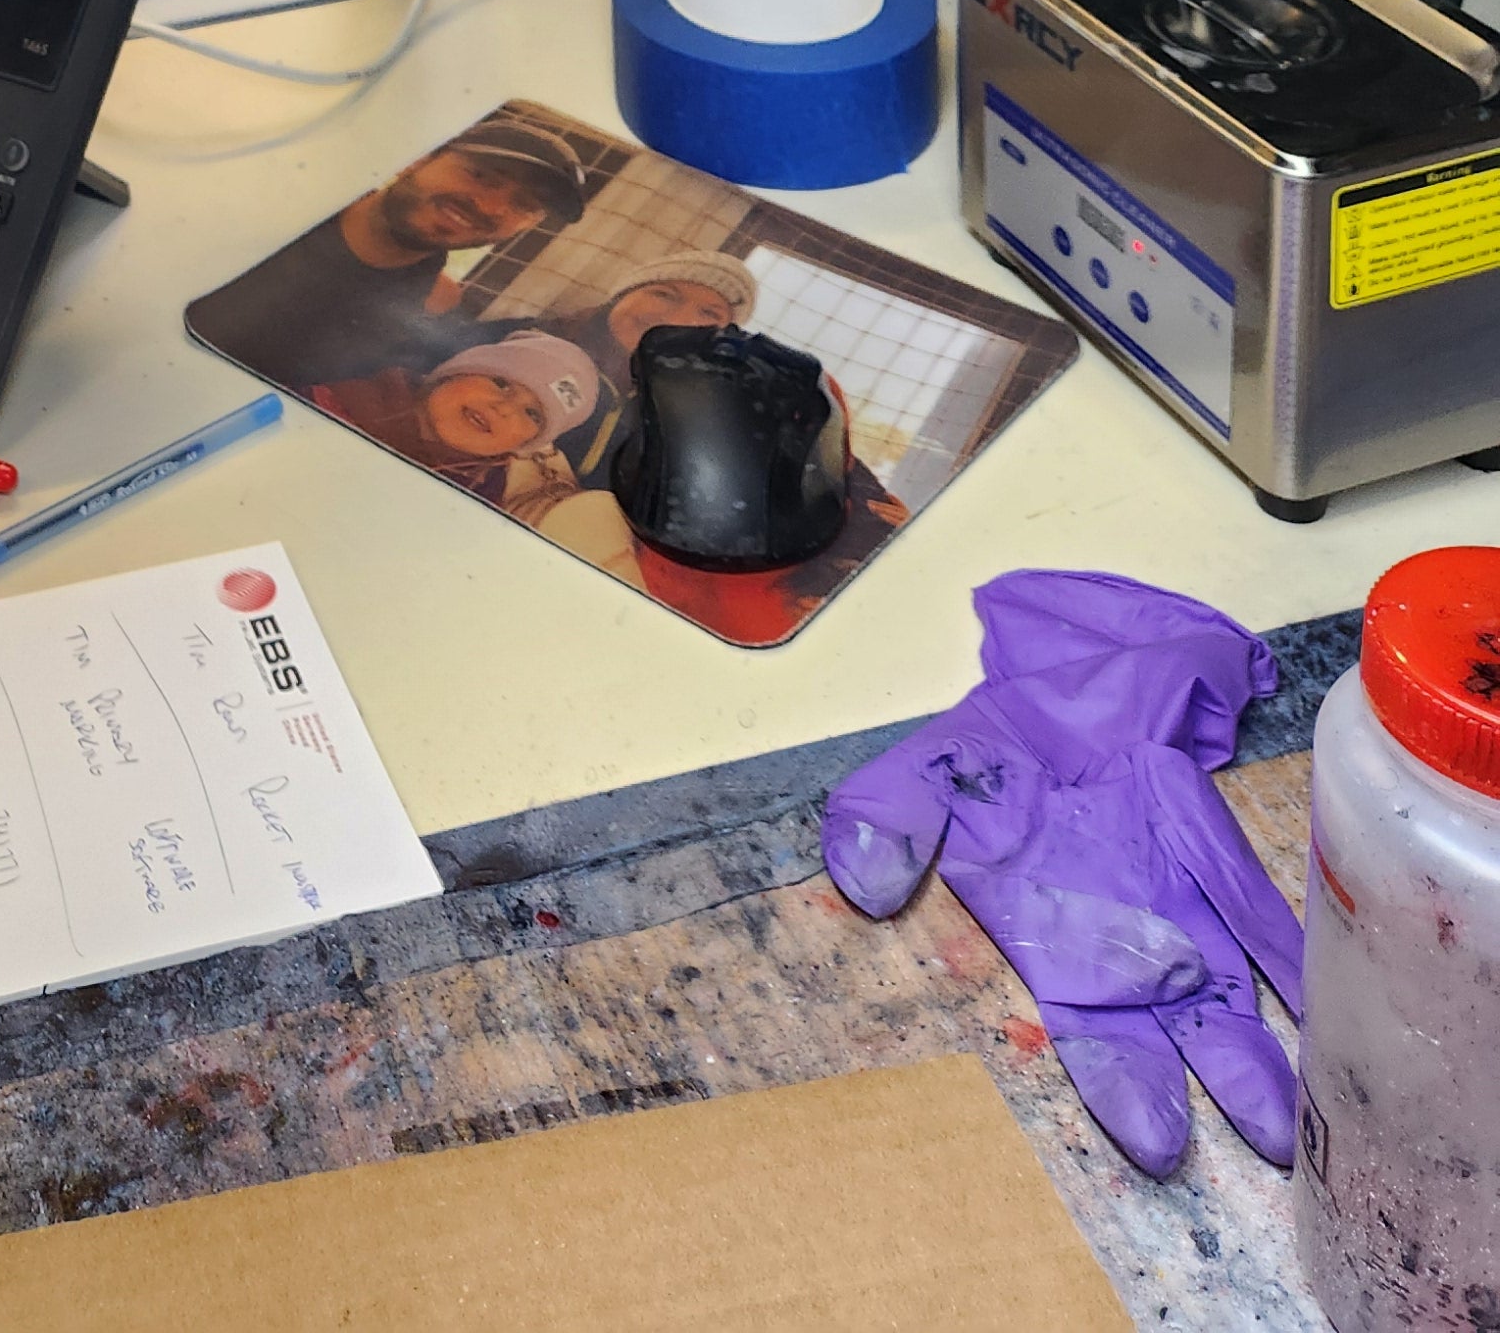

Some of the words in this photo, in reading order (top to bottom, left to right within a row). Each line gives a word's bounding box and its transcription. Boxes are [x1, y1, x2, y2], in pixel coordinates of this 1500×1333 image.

[1426, 165, 1473, 184] Warning
[249, 613, 304, 694] EBS
[302, 714, 322, 754] Germany
